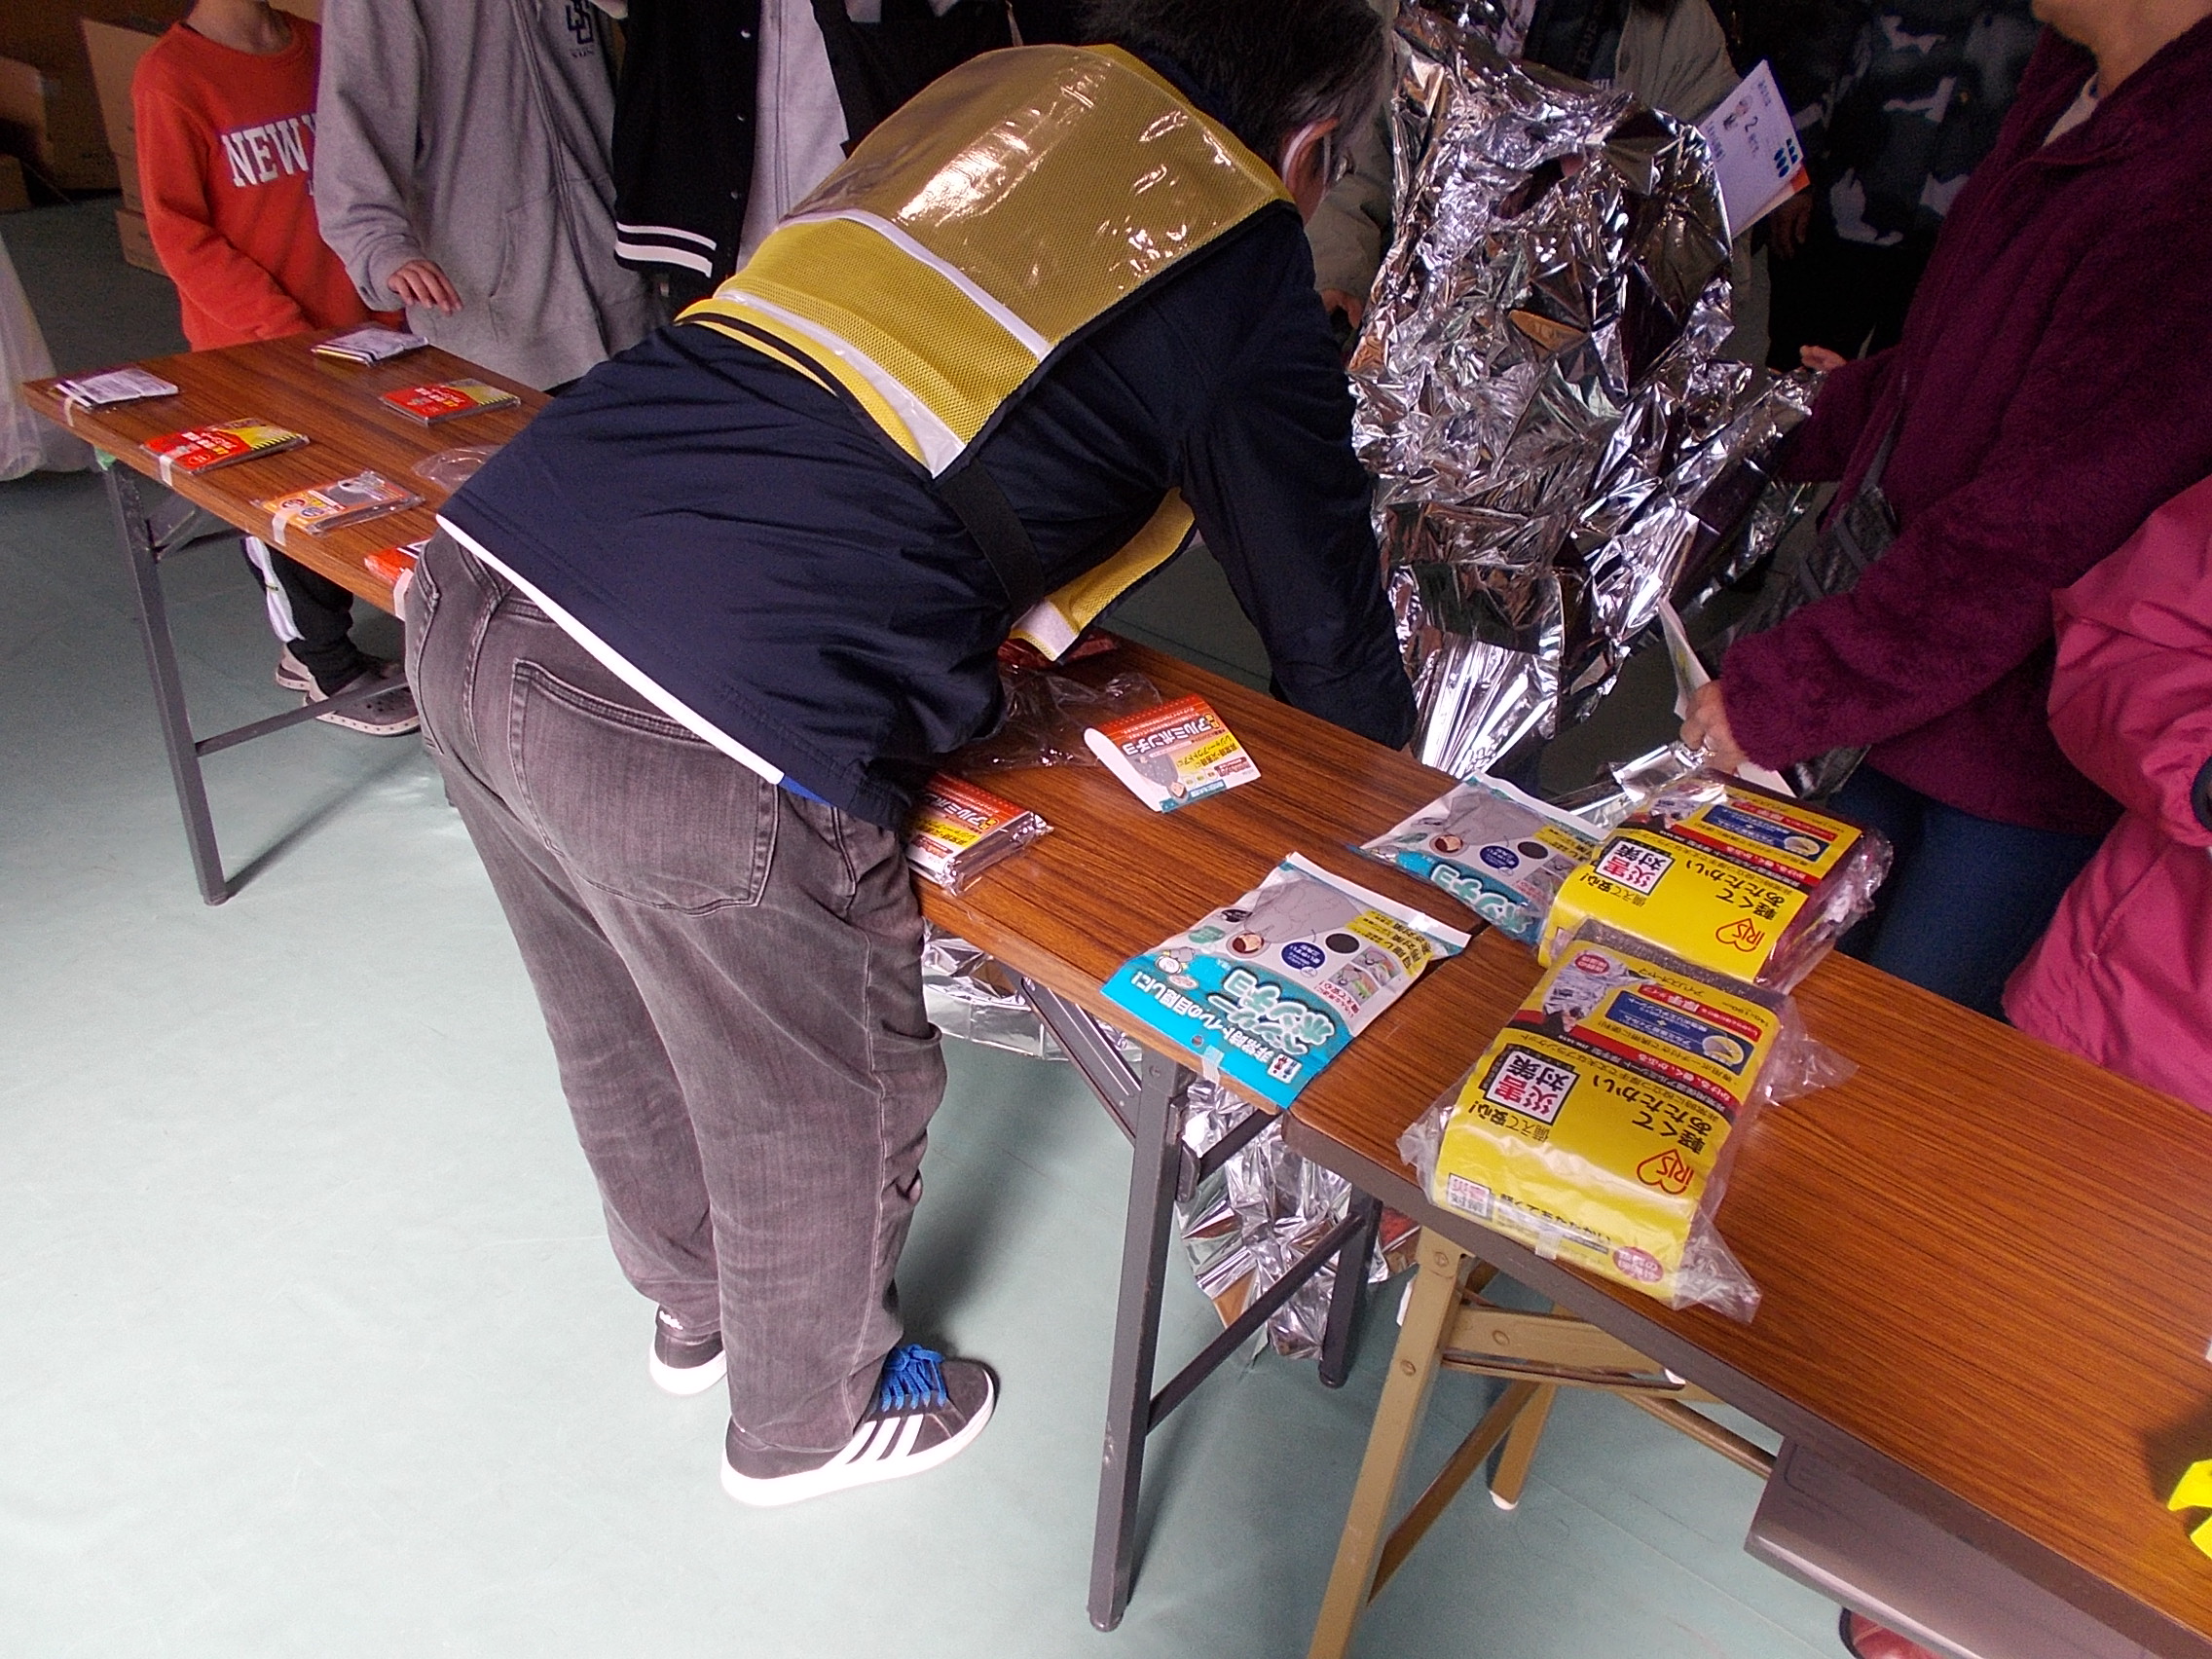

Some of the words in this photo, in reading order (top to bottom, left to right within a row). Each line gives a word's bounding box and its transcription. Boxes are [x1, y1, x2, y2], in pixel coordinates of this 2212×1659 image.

[221, 118, 310, 188] NEW
[1120, 717, 1212, 757] アルミポンチョ
[1600, 856, 1657, 887] 災害
[1609, 842, 1669, 871] 対策
[1577, 872, 1647, 906] 備えて安心!
[1681, 859, 1787, 907] あたたかい
[1714, 887, 1780, 920] 軽くて
[1732, 923, 1765, 945] IRIS
[1130, 972, 1275, 1063] 非常時トイレの目隠しに!
[1223, 967, 1335, 1047] ポンチョ
[1492, 1073, 1559, 1116] 災害
[1504, 1053, 1570, 1093] 対策
[1519, 1032, 1719, 1123] 非常時に役立つ厚手で丈夫なブランケット
[1622, 1059, 1726, 1111] 非常用保温アルミシート
[1467, 1099, 1550, 1142] 備えて安心!
[1589, 1074, 1714, 1136] あたたかい
[1629, 1109, 1707, 1154] 軽くて
[1657, 1155, 1695, 1186] IRIS
